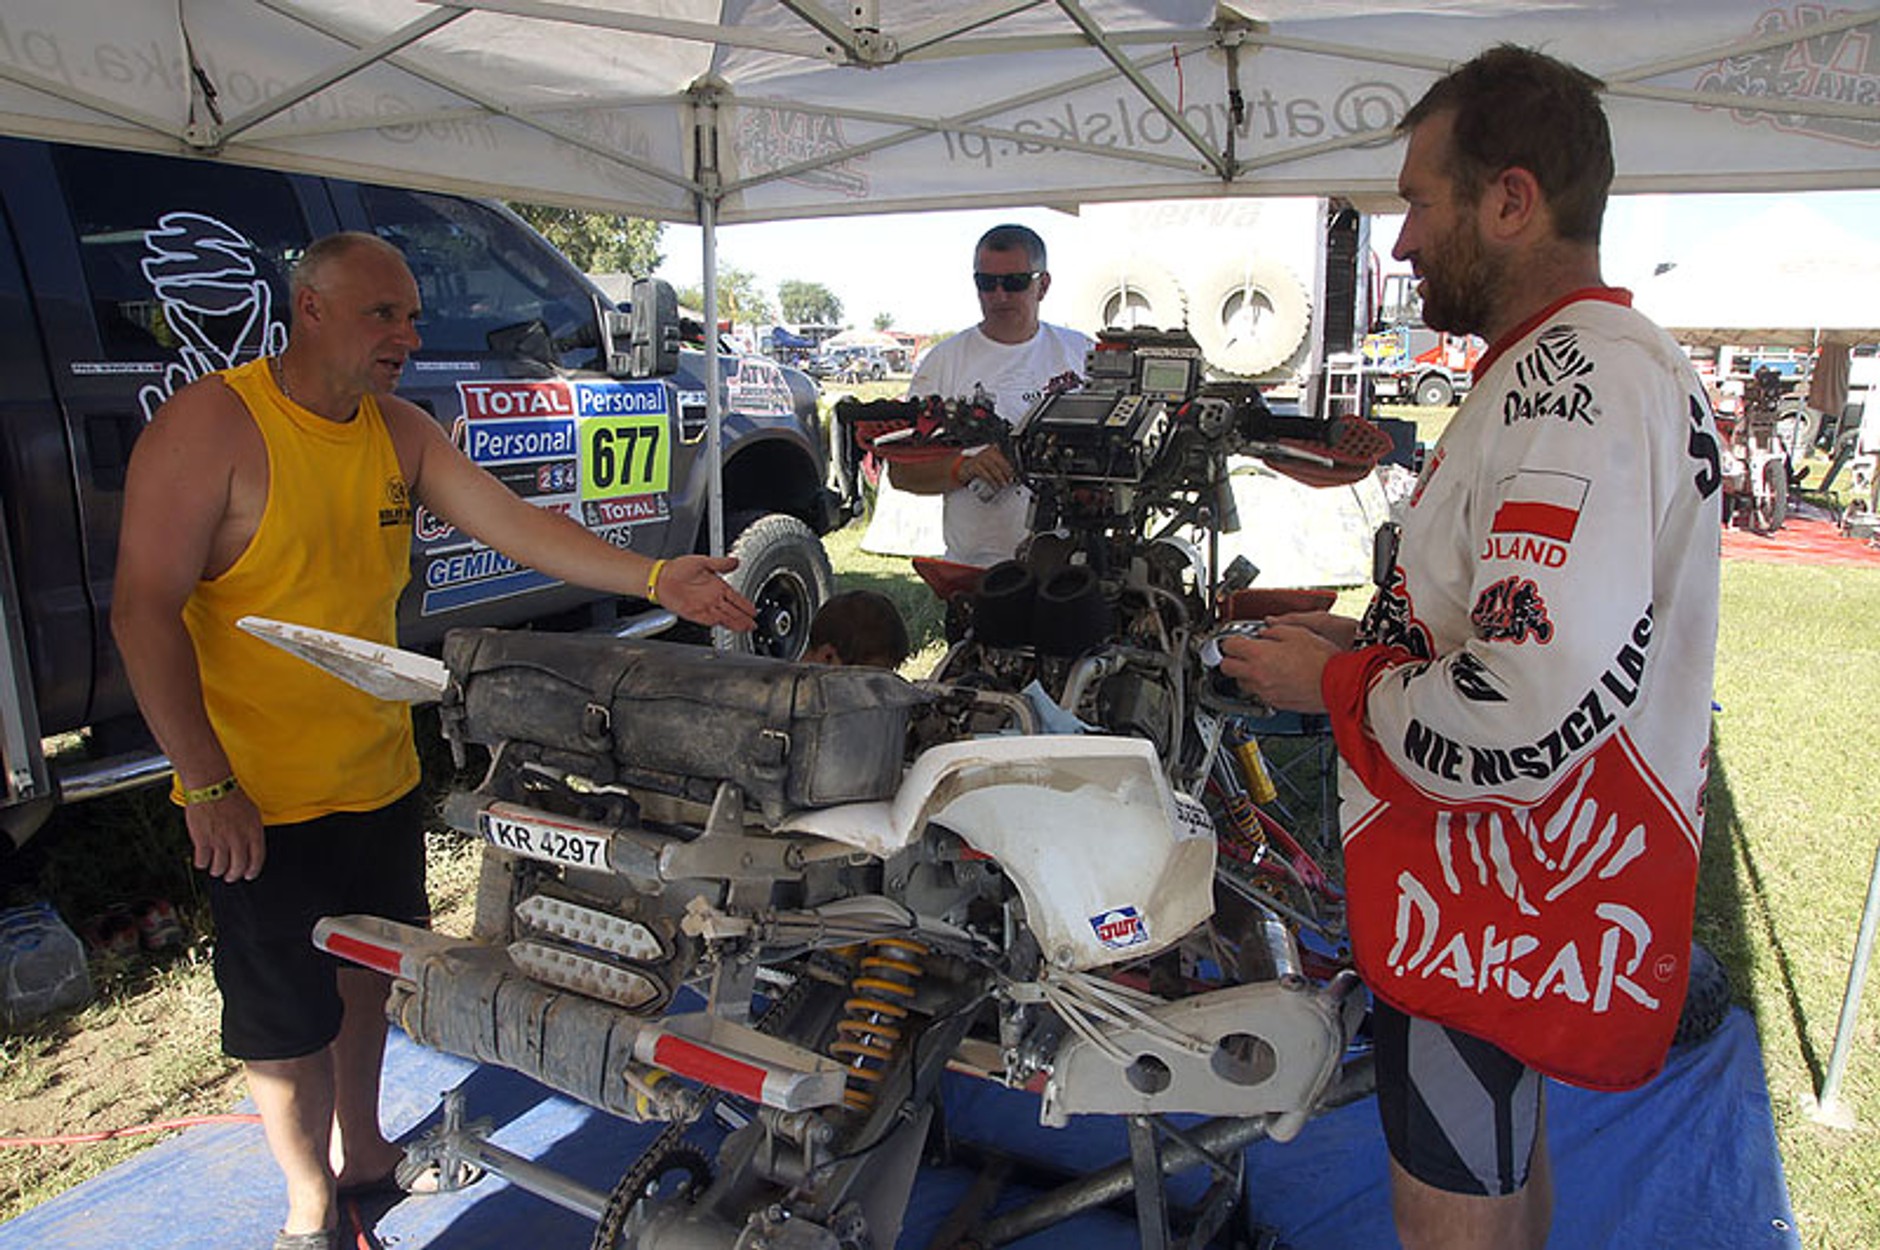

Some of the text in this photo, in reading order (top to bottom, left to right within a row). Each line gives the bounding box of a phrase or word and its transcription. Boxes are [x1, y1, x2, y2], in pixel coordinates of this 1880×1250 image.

[470, 386, 570, 415] TOTAL
[580, 385, 663, 416] Personal
[1504, 383, 1595, 426] DAKAR
[474, 423, 573, 458] Personal
[592, 425, 660, 489] 677
[600, 502, 655, 519] TOTAL
[1404, 719, 1463, 783] NIE
[497, 822, 600, 865] KR 4297
[1387, 871, 1659, 1012] DAKAR
